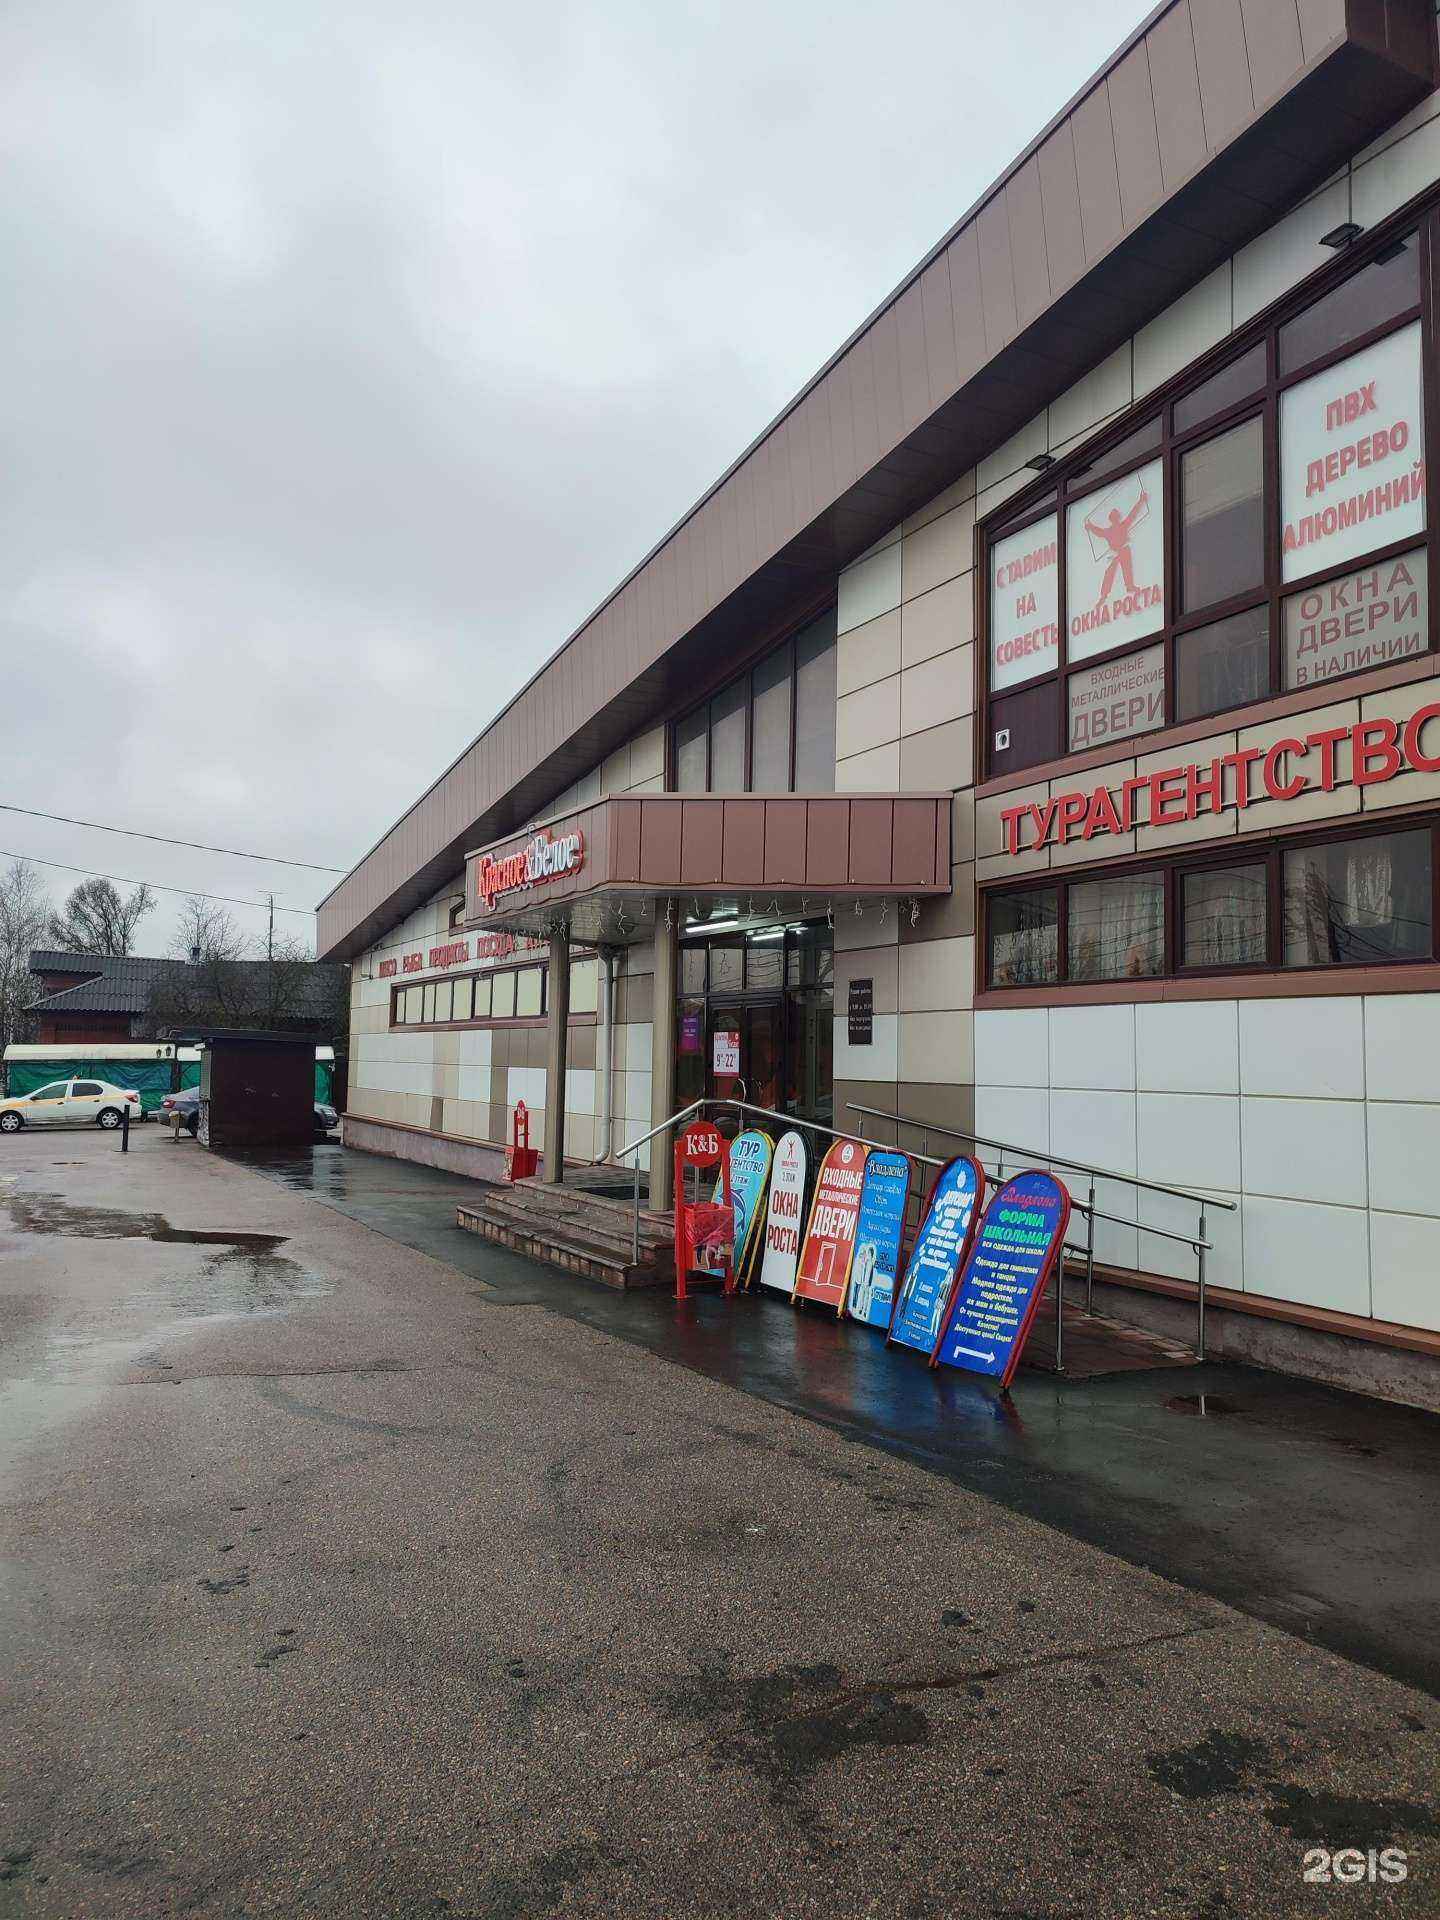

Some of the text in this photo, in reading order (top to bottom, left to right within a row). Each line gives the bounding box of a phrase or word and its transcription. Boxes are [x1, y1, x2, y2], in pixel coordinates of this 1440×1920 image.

[1326, 380, 1377, 431] ПВХ
[1305, 421, 1409, 497] ДЕРЕВО
[1282, 458, 1426, 556] АЛЮМИНИЙ
[996, 542, 1057, 588] СТАВИМ
[1016, 592, 1036, 618] НА
[1071, 584, 1162, 636] ОКНА РОСТА
[1301, 561, 1414, 620] ОКНА
[996, 622, 1059, 666] СОВЕСТЬ
[1296, 591, 1418, 659] ДВЕРИ
[1091, 656, 1144, 685] ВХОДНЫЕ
[1296, 631, 1420, 685] В НАЛИЧИИ
[1072, 667, 1164, 708] МЕТАЛЛИЧЕСКИЕ
[1072, 689, 1165, 750] ДВЕРИ
[1000, 703, 1440, 856] ТУРАГЕНТСТВО
[731, 1158, 765, 1173] ГЕНТСТВО
[739, 1140, 760, 1157] ТУР
[821, 1167, 863, 1189] ВХОДНЫЕ
[773, 1189, 799, 1218] ОКНА
[810, 1205, 857, 1241] ДВЕРИ
[999, 1208, 1045, 1228] ФОРМА
[767, 1224, 797, 1255] РОСТА
[982, 1225, 1053, 1246] ШКОЛЬНАЯ
